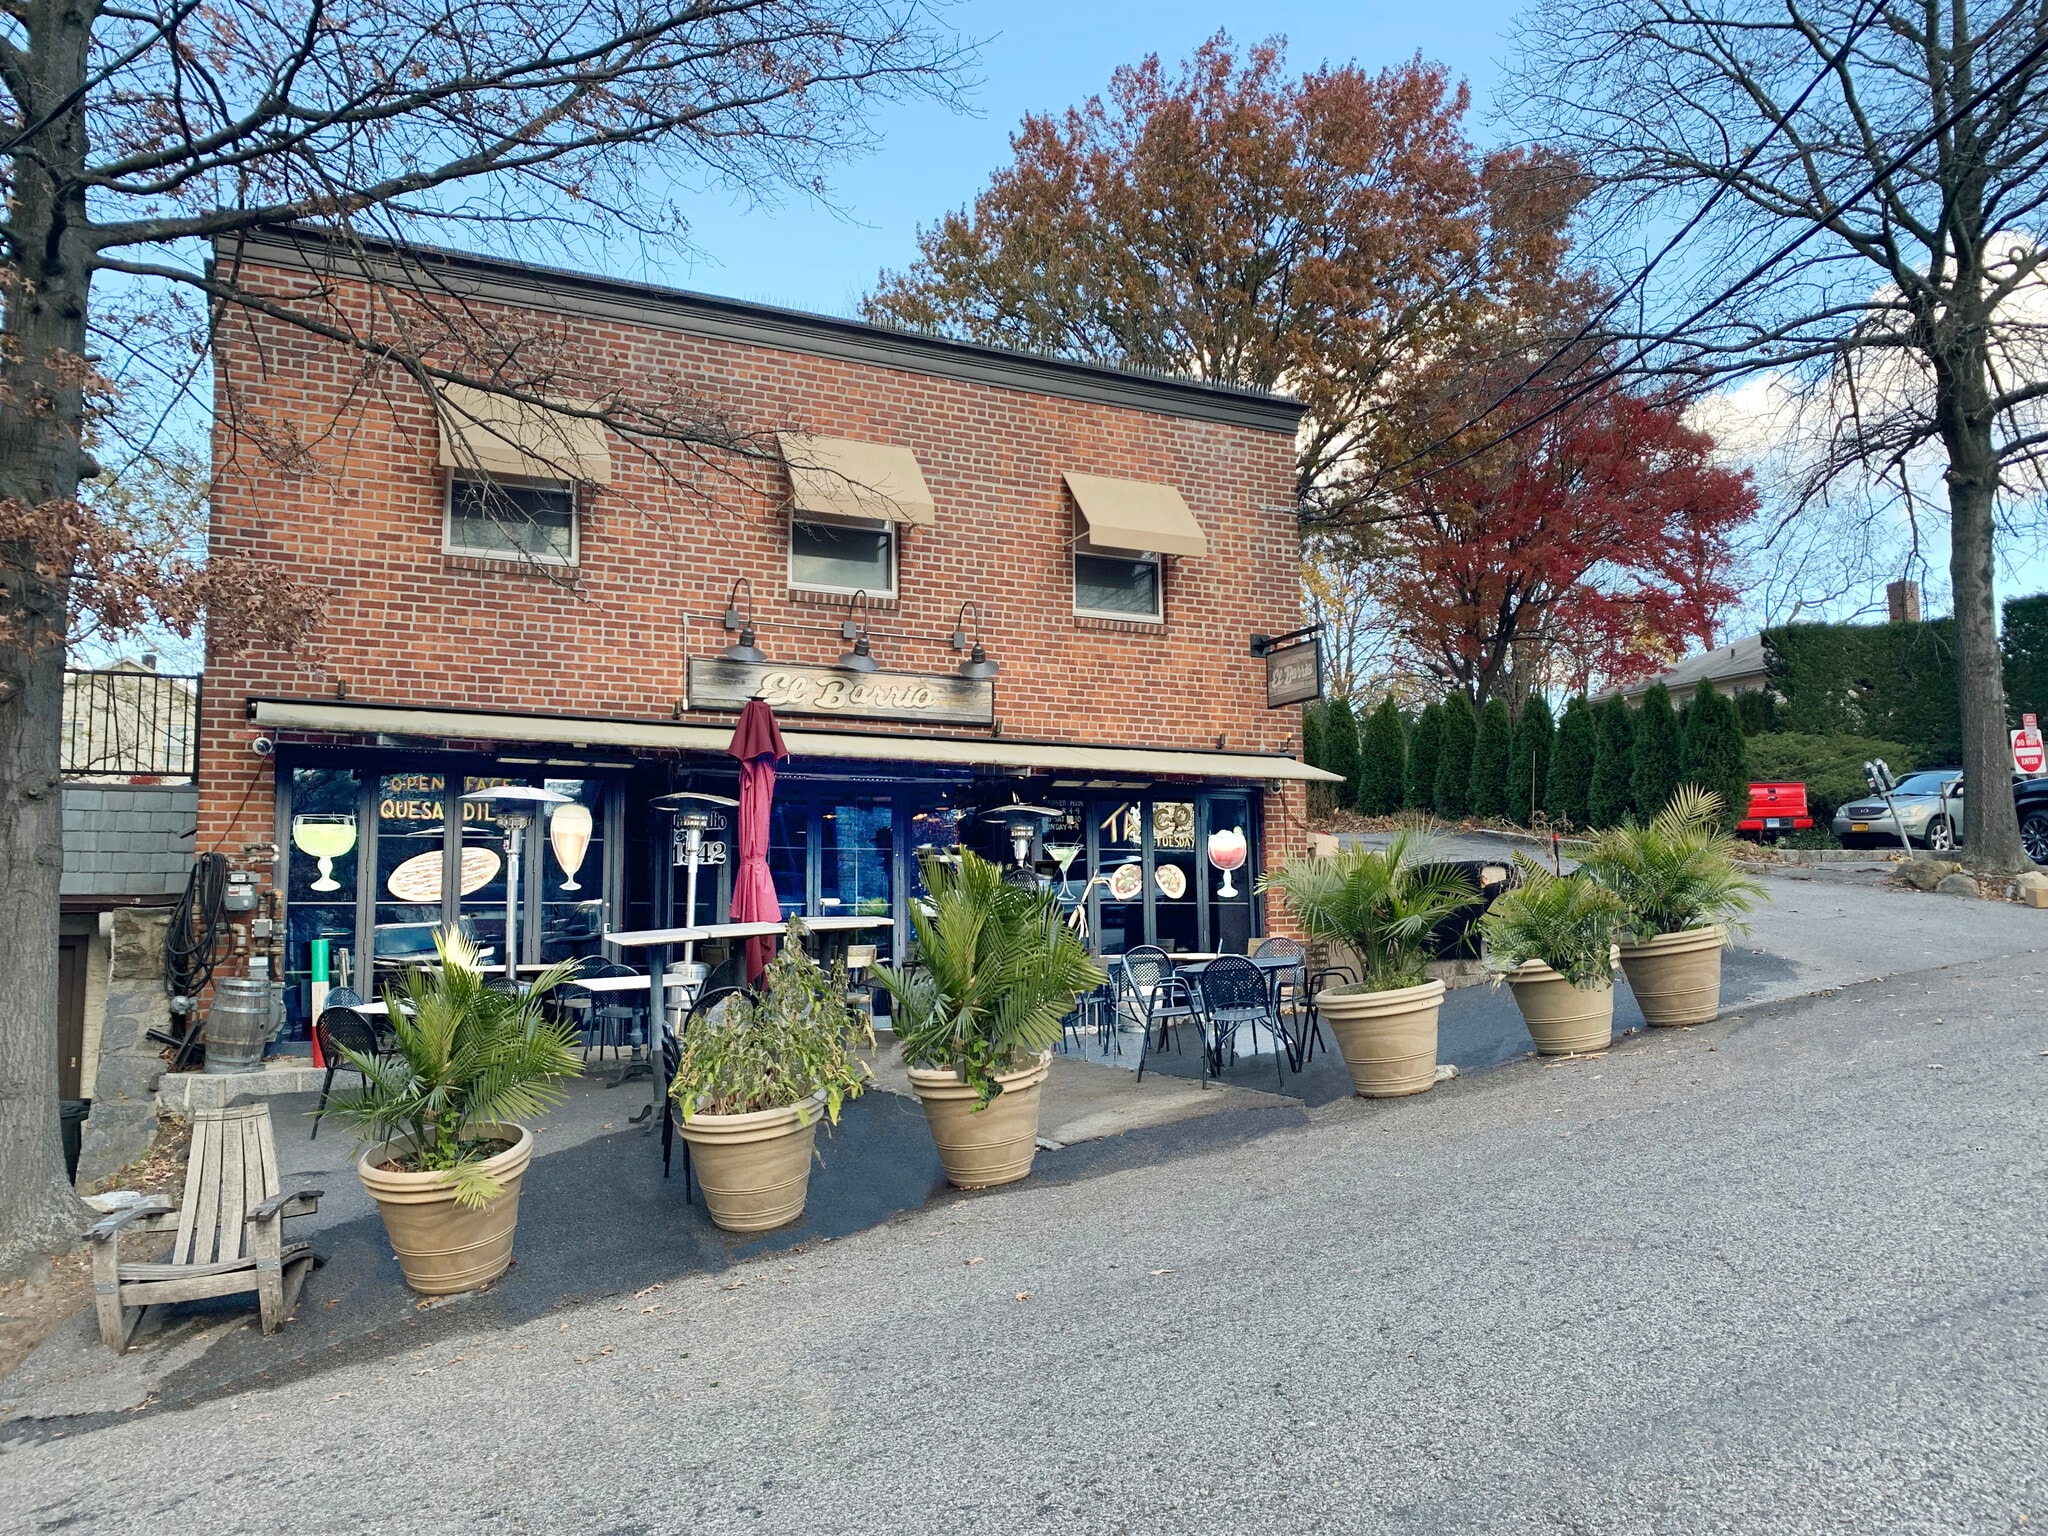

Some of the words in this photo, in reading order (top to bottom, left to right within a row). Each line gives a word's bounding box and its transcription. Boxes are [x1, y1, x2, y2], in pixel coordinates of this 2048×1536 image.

[1271, 668, 1284, 689] El
[1284, 663, 1314, 685] Barrio
[755, 672, 808, 706] El
[814, 676, 938, 710] Barrio
[2017, 738, 2025, 746] DO
[2026, 738, 2038, 746] NOT
[2021, 757, 2039, 765] ENTER
[390, 776, 445, 792] OPEN
[1042, 823, 1067, 831] SUNDAY
[1155, 836, 1195, 848] TUESDAY
